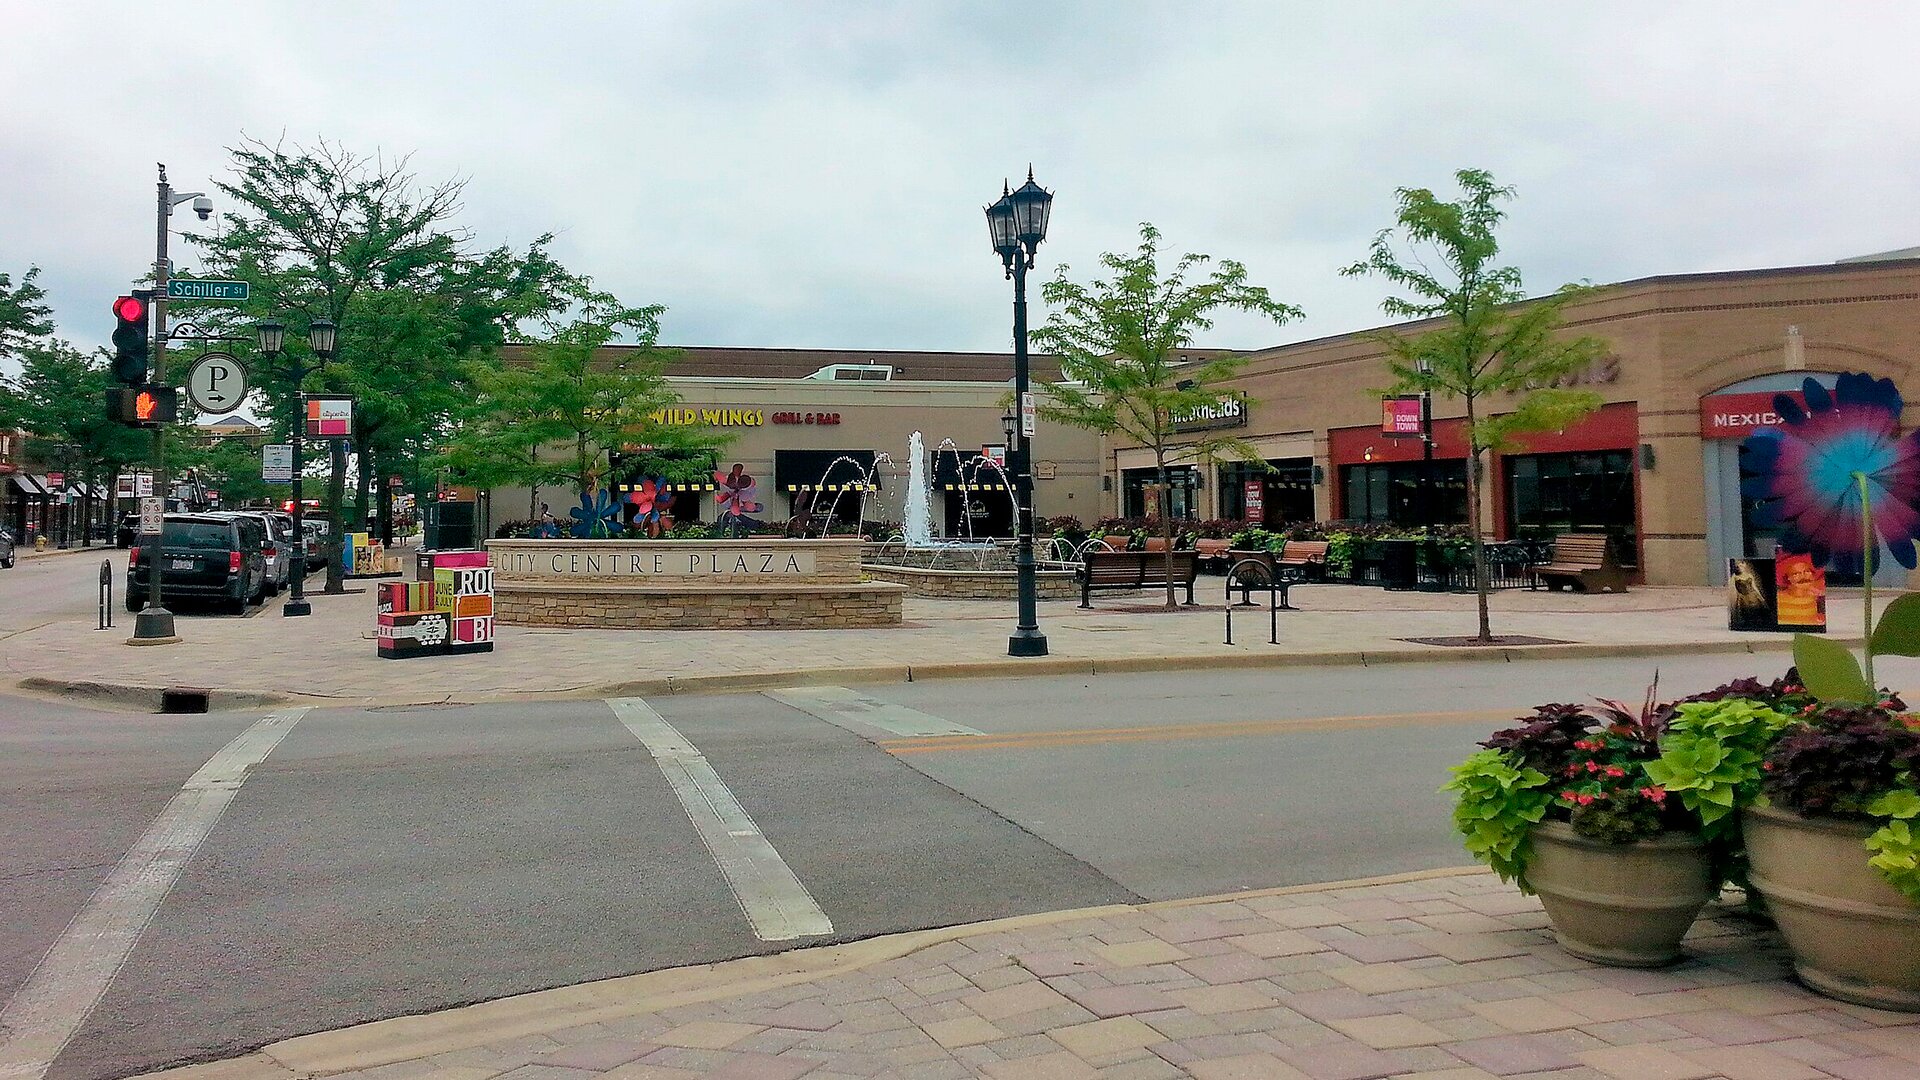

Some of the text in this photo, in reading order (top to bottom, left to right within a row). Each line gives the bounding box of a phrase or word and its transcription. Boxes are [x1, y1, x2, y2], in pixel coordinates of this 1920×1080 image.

[174, 282, 242, 297] Schiller St
[207, 365, 229, 392] P
[647, 408, 698, 425] WILD
[701, 408, 764, 426] WINGS
[771, 412, 803, 425] GRILL
[804, 412, 815, 425] &
[816, 412, 841, 425] BAR
[1396, 414, 1419, 422] DOWN
[1714, 411, 1786, 428] MEXIC
[1396, 422, 1419, 430] TOWN
[501, 553, 801, 573] CITY CENTRE PLAZA
[435, 583, 453, 596] JUNE
